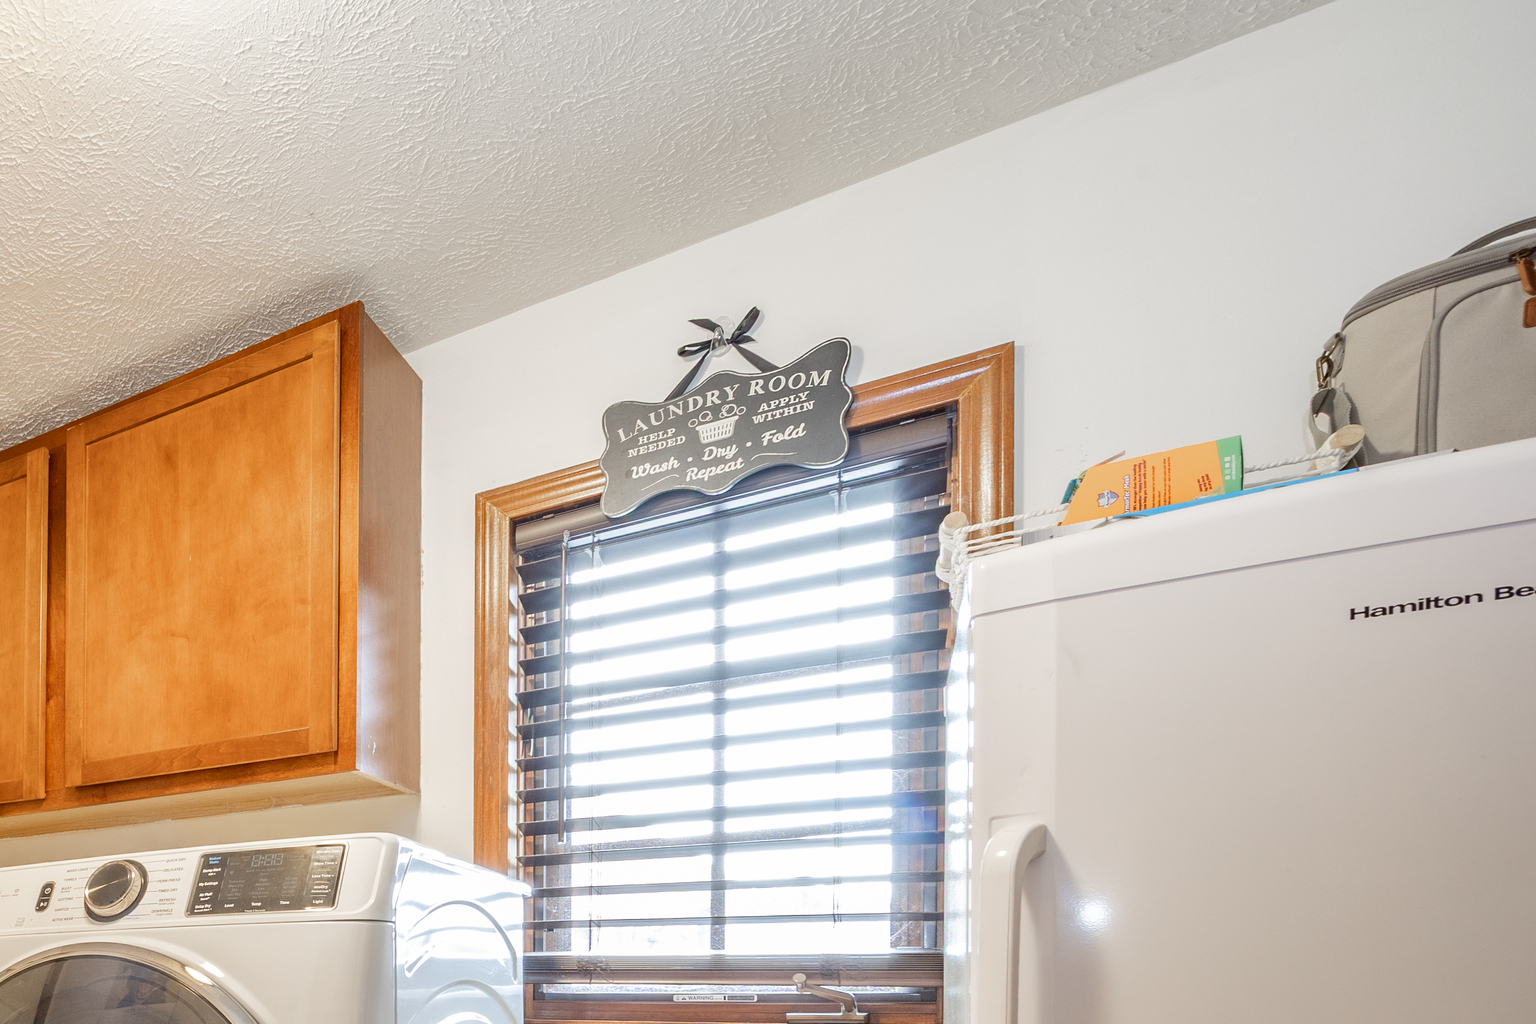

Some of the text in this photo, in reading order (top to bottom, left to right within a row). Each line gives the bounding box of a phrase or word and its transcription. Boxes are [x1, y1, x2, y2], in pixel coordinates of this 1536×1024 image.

[617, 369, 832, 443] LAUNDRY ROOM
[752, 400, 815, 424] WITHIN
[757, 391, 810, 412] APPLY
[627, 435, 686, 458] NEEDED
[637, 428, 676, 445] HELP
[630, 422, 806, 479] Wash Dry Fold
[686, 457, 745, 482] Repeat
[1349, 585, 1536, 621] Hamilton Be
